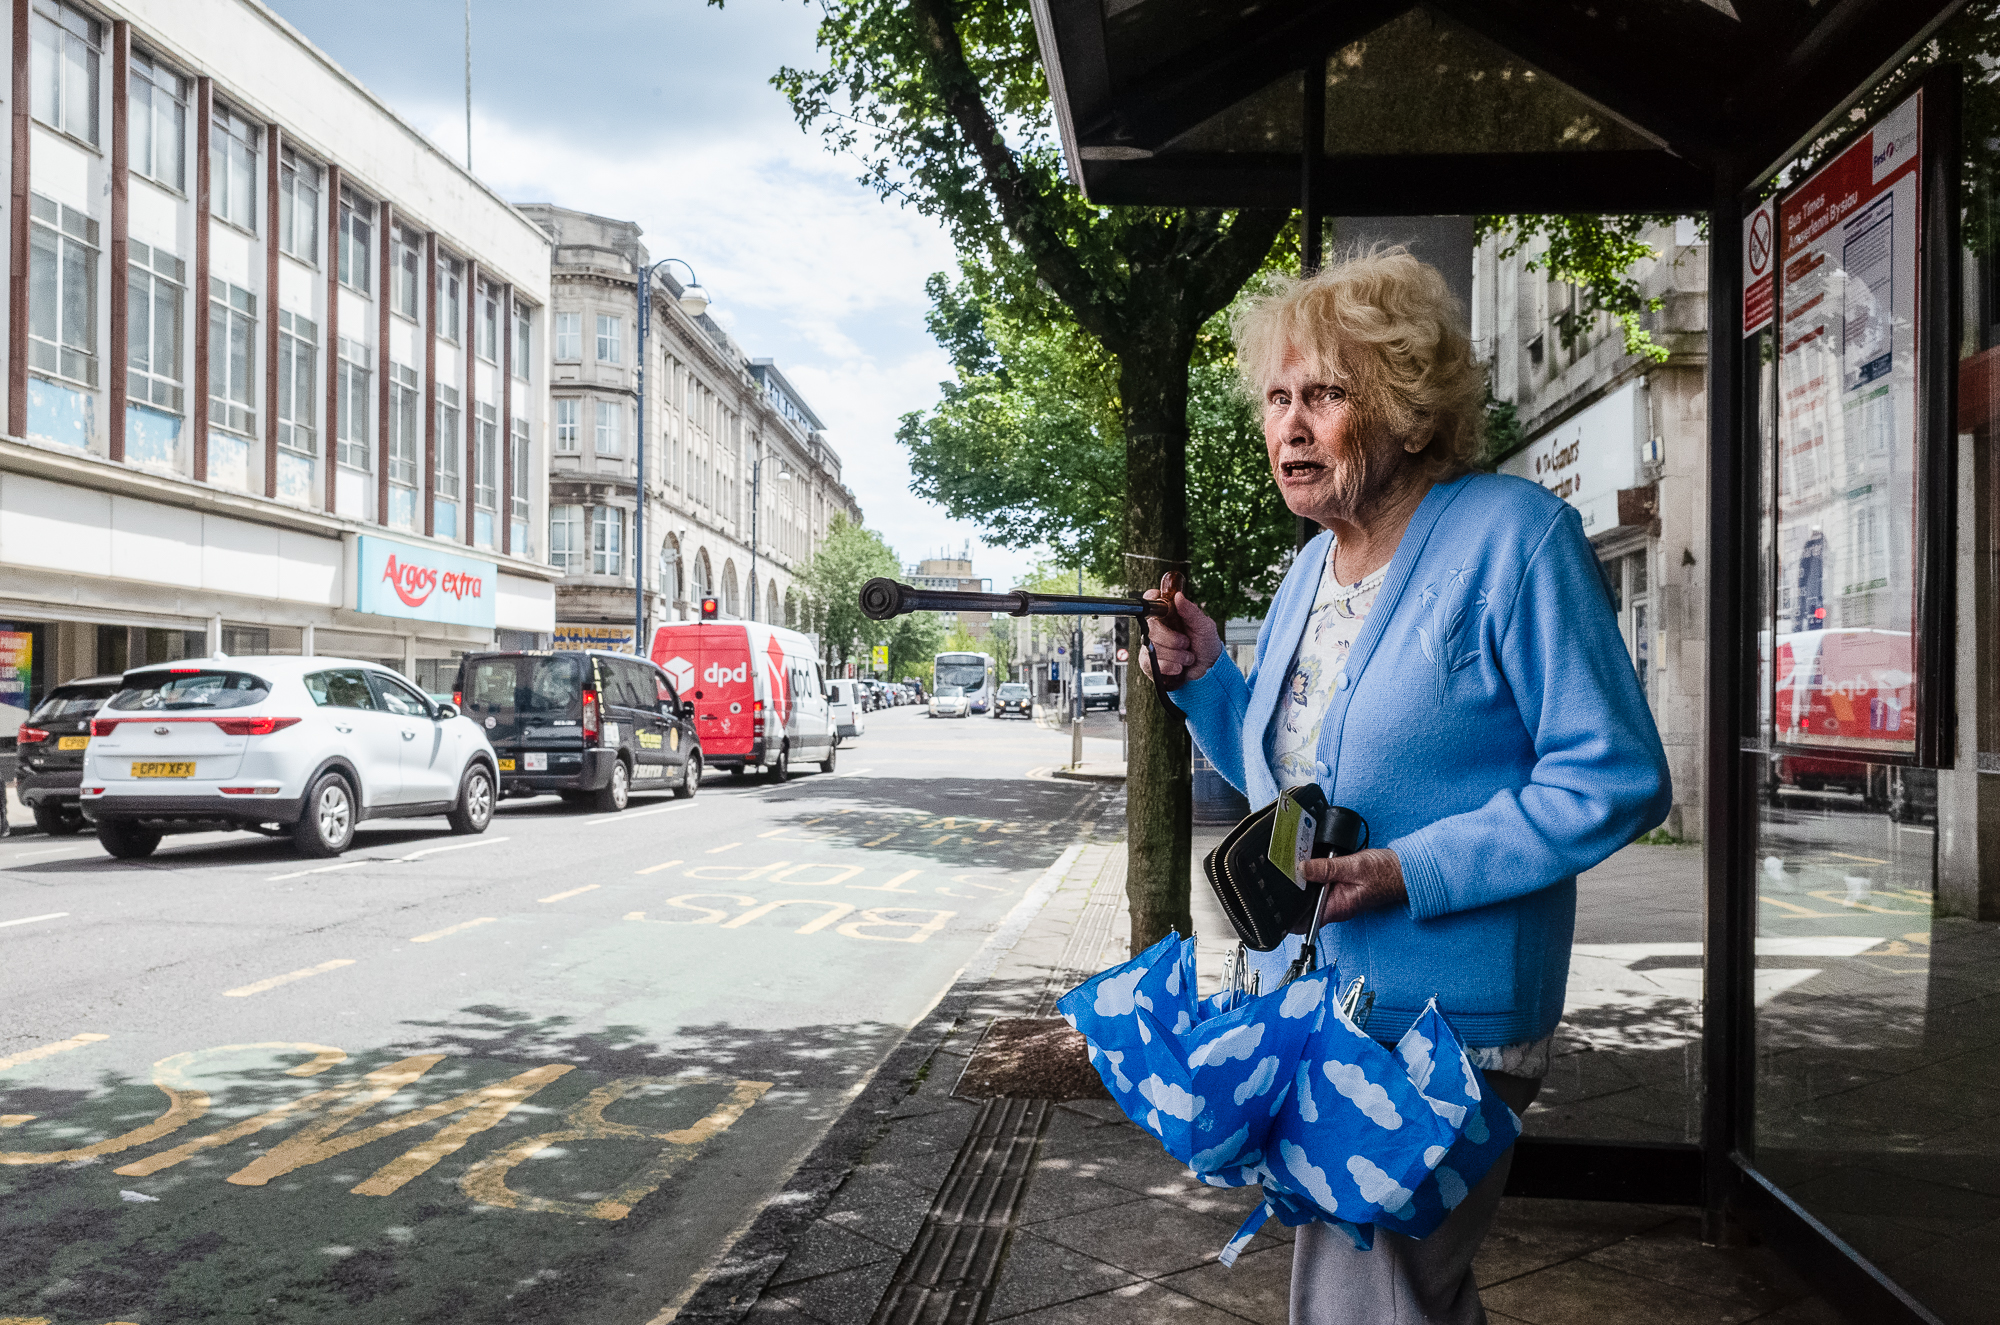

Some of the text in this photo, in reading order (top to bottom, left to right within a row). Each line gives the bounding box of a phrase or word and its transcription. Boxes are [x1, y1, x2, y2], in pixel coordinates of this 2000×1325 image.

[1788, 193, 1826, 231] Bus Times
[382, 554, 482, 607] Argos extra
[554, 626, 633, 639] WANSEA
[554, 641, 634, 654] ARPETS
[703, 662, 747, 688] dpd
[140, 762, 192, 774] CP17 XFX
[683, 861, 1022, 899] STOP
[622, 893, 957, 943] BUS
